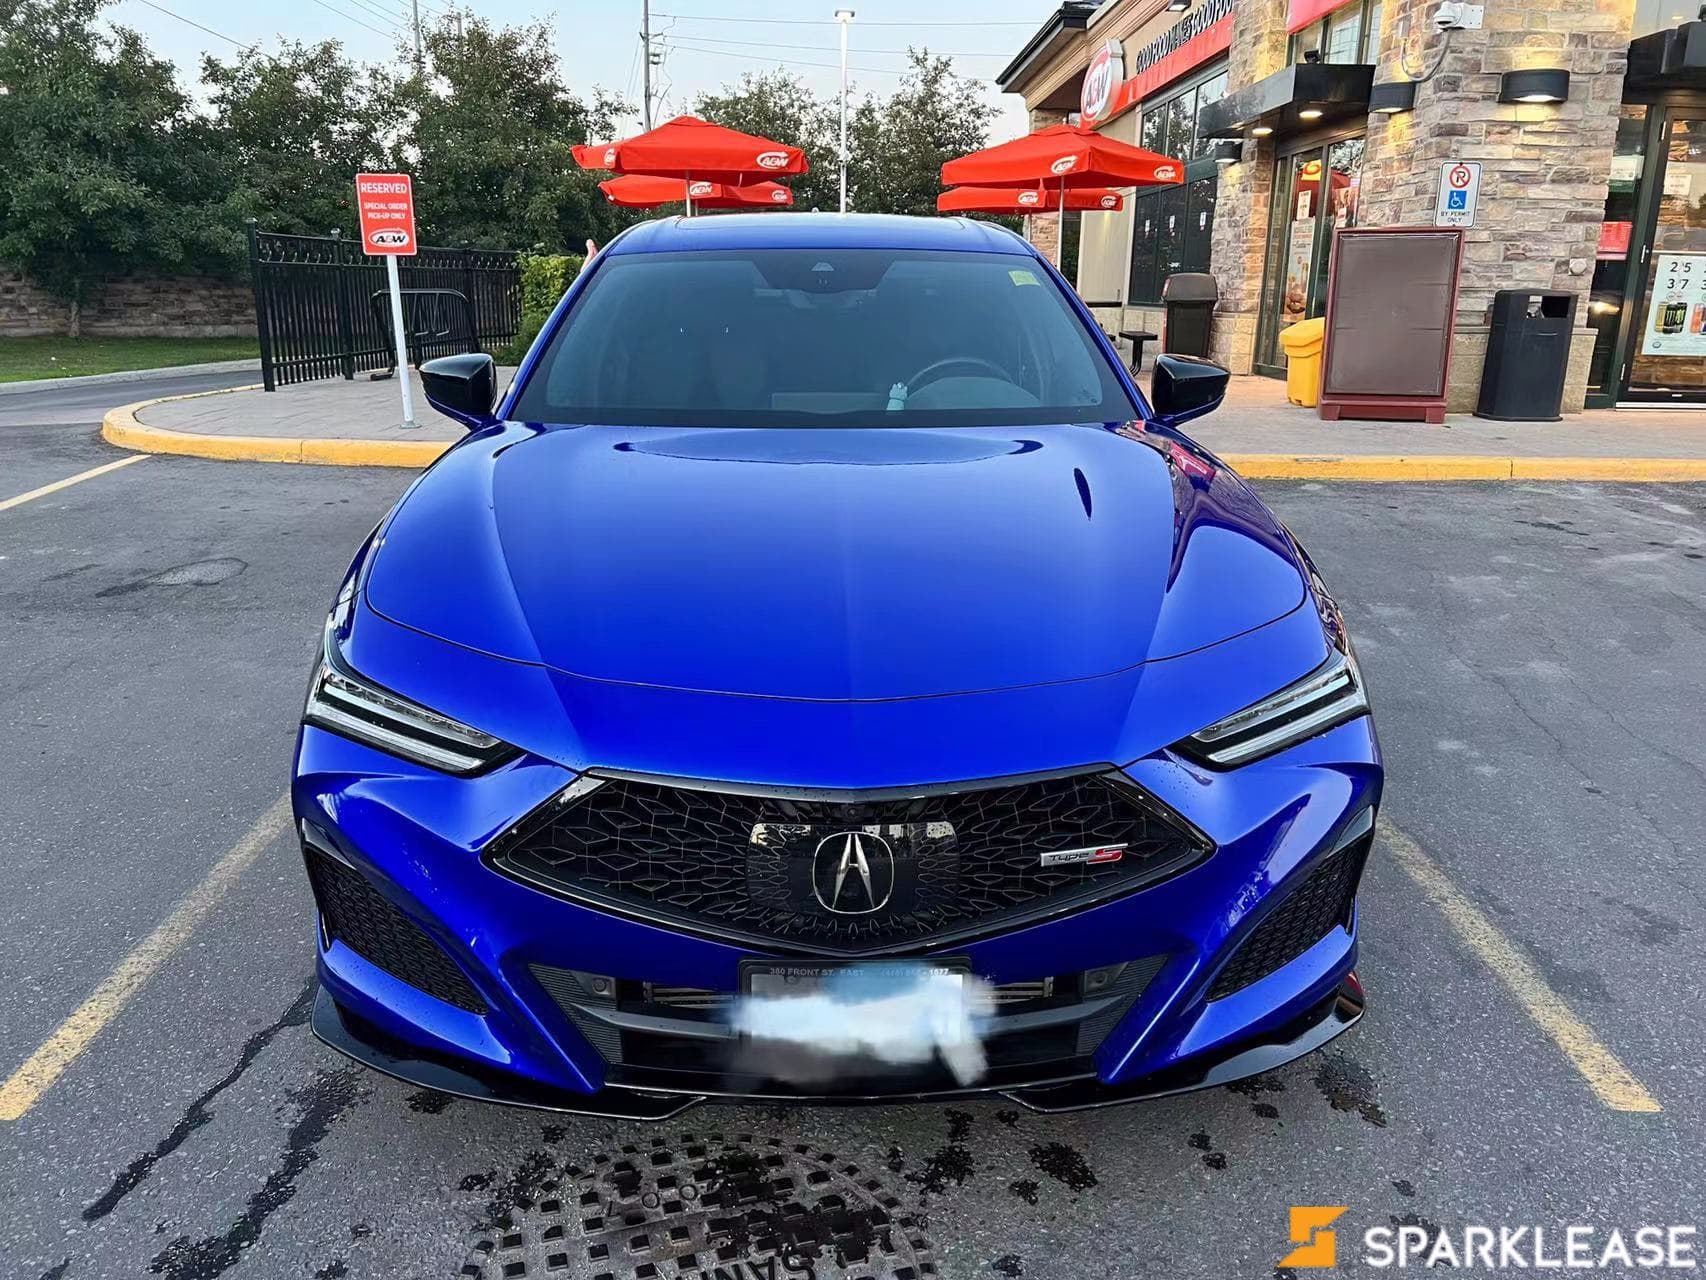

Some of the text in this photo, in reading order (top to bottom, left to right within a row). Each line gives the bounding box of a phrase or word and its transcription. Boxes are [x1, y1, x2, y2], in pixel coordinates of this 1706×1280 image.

[360, 182, 408, 194] RESERVED
[364, 202, 407, 210] SPECIAL ORDER
[367, 212, 405, 220] PICK-UP ONLY
[375, 235, 406, 243] A&W
[787, 968, 820, 977] FRONT
[840, 968, 865, 977] EAST
